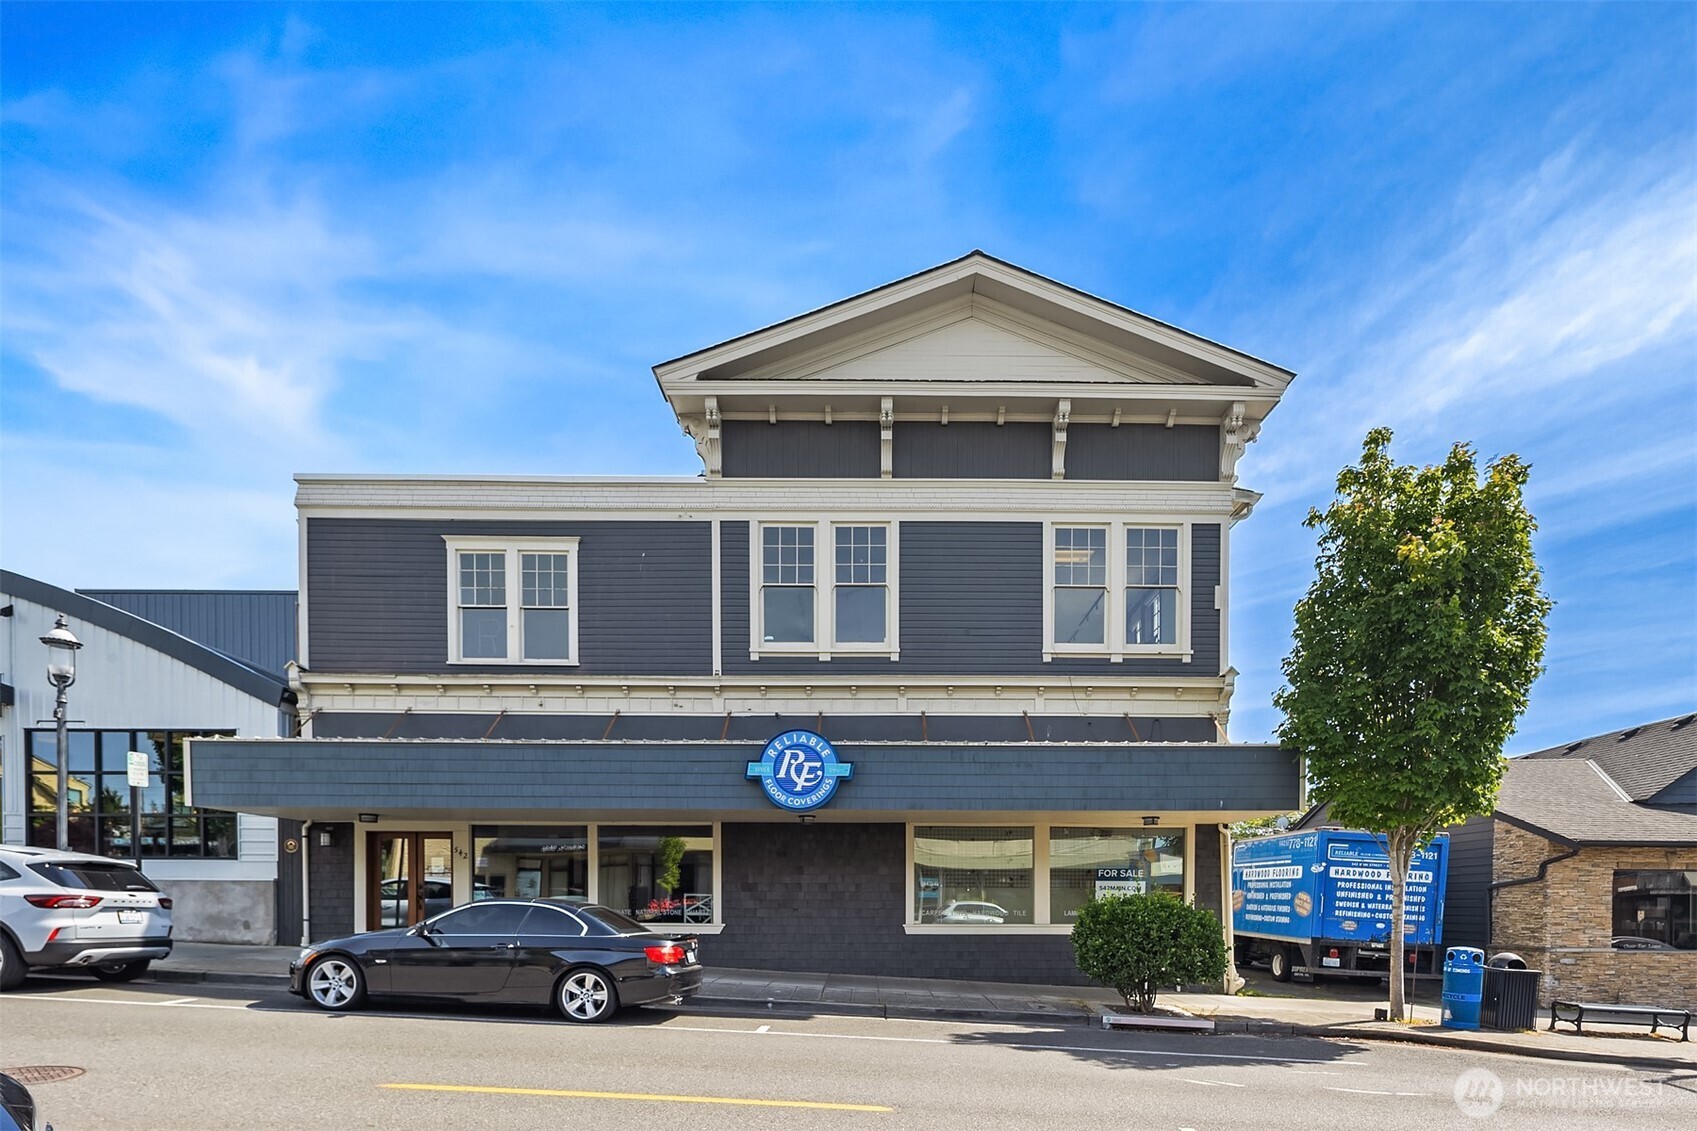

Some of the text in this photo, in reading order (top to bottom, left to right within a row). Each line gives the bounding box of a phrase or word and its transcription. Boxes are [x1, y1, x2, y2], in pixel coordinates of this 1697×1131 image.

[767, 733, 831, 758] RELIABLE
[765, 778, 833, 806] FLOOR COVERINGS
[454, 846, 468, 860] 542
[1098, 869, 1144, 878] FOR SALE
[1334, 868, 1382, 878] HARDWOOD
[1337, 881, 1383, 891] PROFESSIONAL
[1336, 891, 1374, 900] UNFINISHED
[1335, 900, 1360, 909] SWEDISH
[1367, 903, 1393, 911] WATERBA
[1335, 910, 1371, 918] REFINISHING
